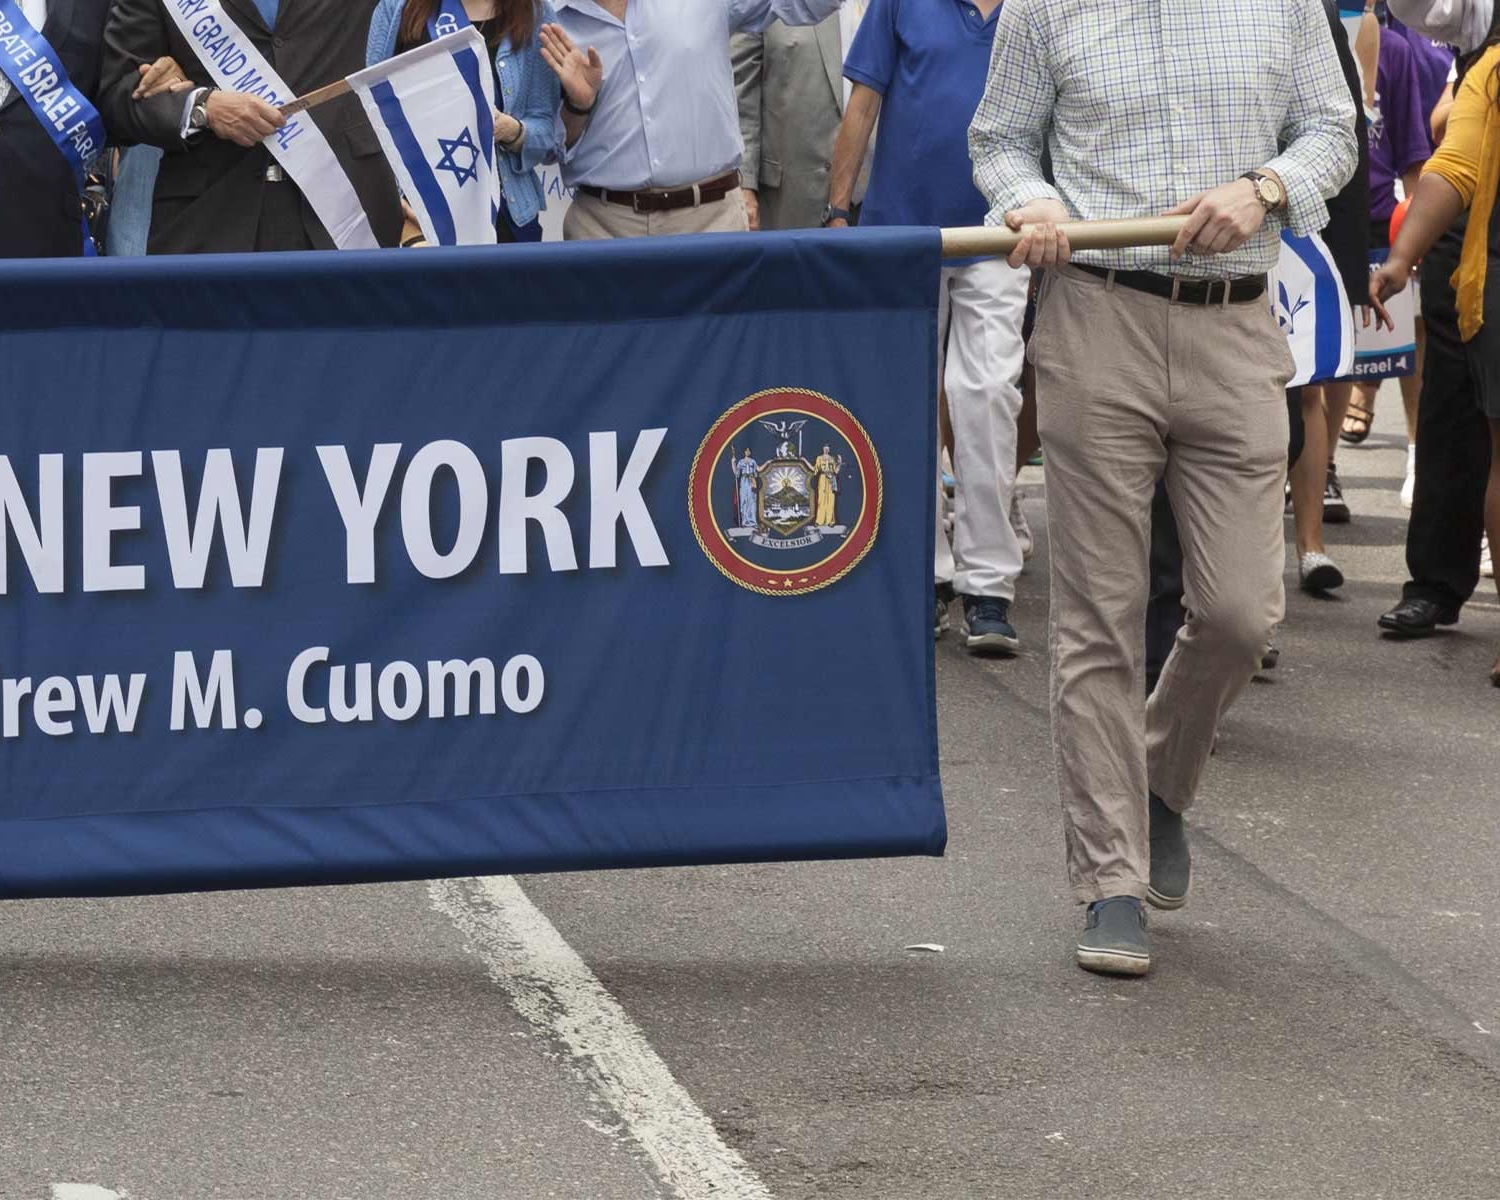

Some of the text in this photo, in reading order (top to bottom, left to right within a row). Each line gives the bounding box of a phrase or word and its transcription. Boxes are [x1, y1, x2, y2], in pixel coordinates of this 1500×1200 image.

[192, 13, 249, 77] GRAND
[18, 57, 81, 132] ISRAEL
[316, 428, 670, 584] YORK
[761, 535, 813, 548] EXCELSIOR
[171, 650, 263, 731] M.
[286, 646, 545, 723] Cuomo
